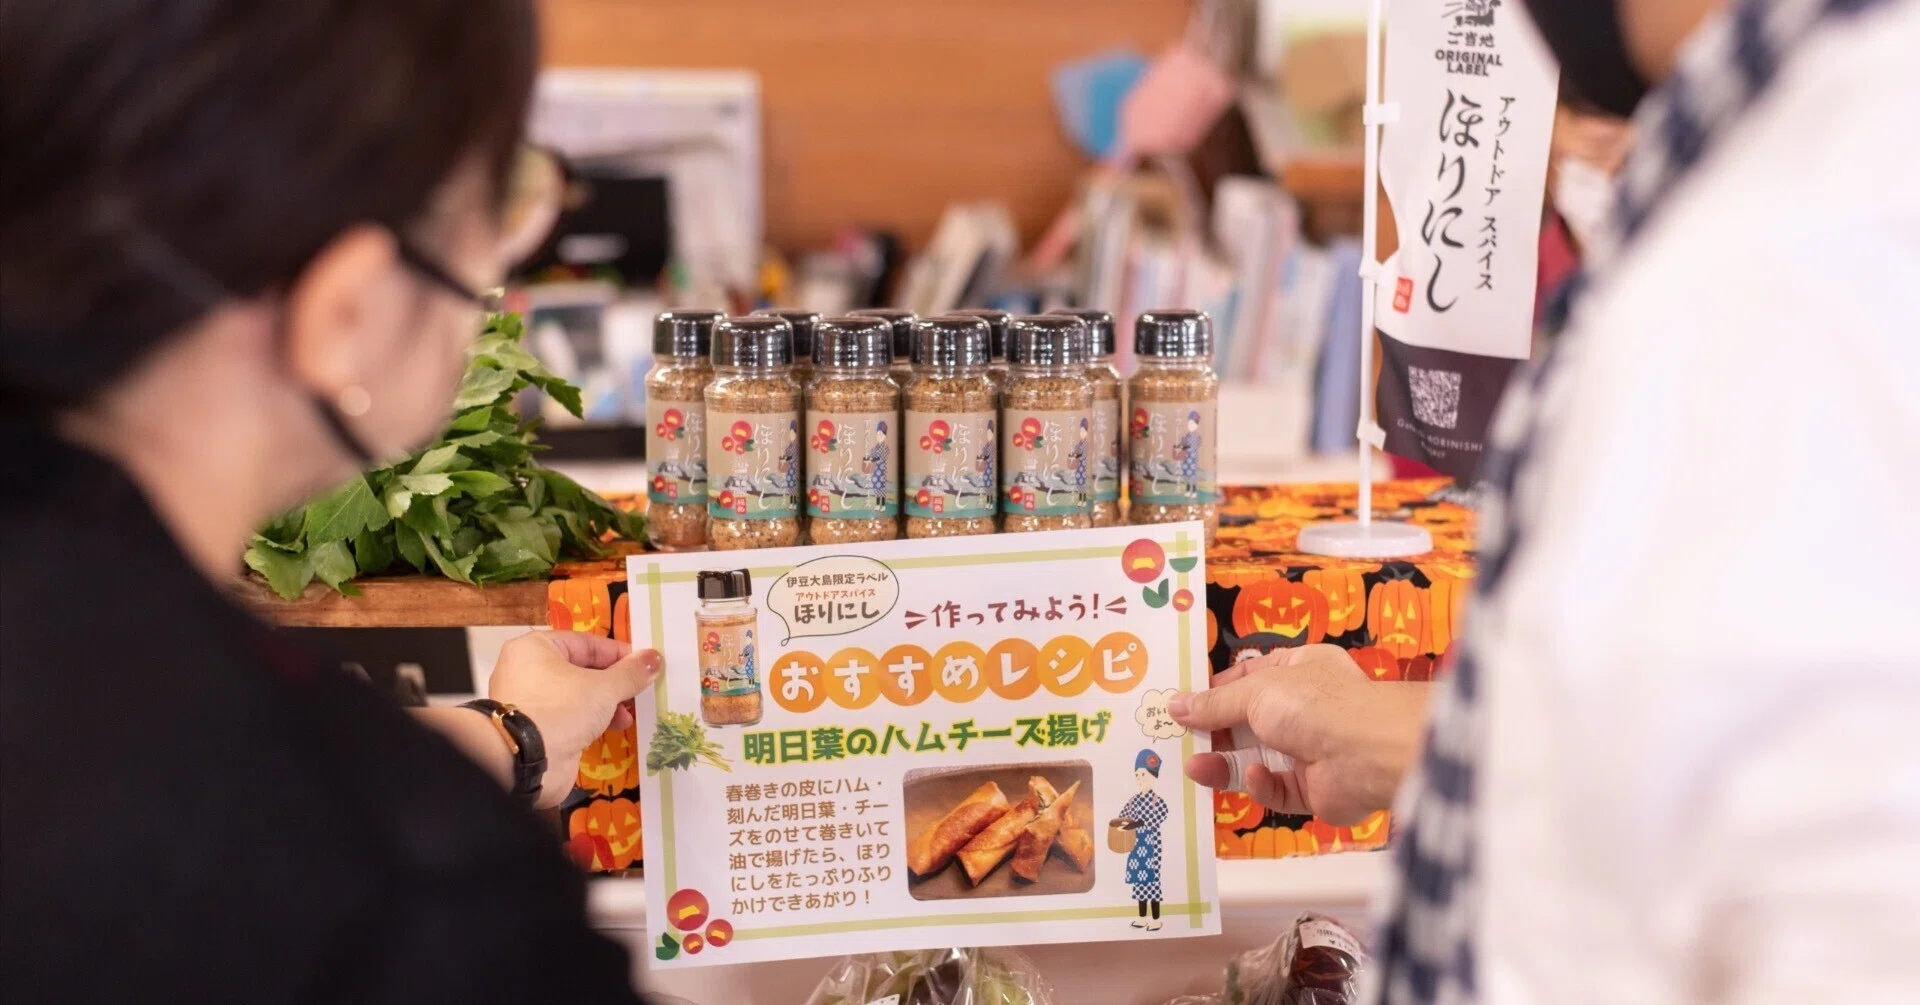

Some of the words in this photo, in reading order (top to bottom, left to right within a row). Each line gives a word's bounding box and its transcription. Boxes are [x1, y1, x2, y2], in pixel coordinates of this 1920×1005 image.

[1447, 31, 1495, 48] ご当地
[1435, 49, 1503, 66] ORIGINAL
[1447, 61, 1489, 77] LABEL
[1421, 88, 1484, 313] ほりにし
[754, 422, 773, 510] ほりにし
[836, 423, 856, 510] ほりにし
[952, 422, 971, 509] ほりにし
[1043, 420, 1062, 507] ほりにし
[786, 572, 888, 588] 伊豆大島限定ラベル
[796, 588, 876, 601] アウトドアスパイス
[795, 601, 880, 624] ほりにし
[931, 593, 1099, 628] 作ってみよう!
[780, 641, 1141, 702] おすすめレシピ
[743, 711, 1112, 764] 明日葉のハムチーズ揚げ
[725, 777, 882, 802] 春巻きの皮にハム・
[727, 799, 889, 825] 刻んだ明日葉・チー
[729, 821, 889, 847] ズをのせて巻きいて
[729, 843, 890, 870] 油で揚げたら、ほり
[731, 866, 891, 892] にしをたっぷりふり
[732, 890, 870, 915] かけできあがり！
